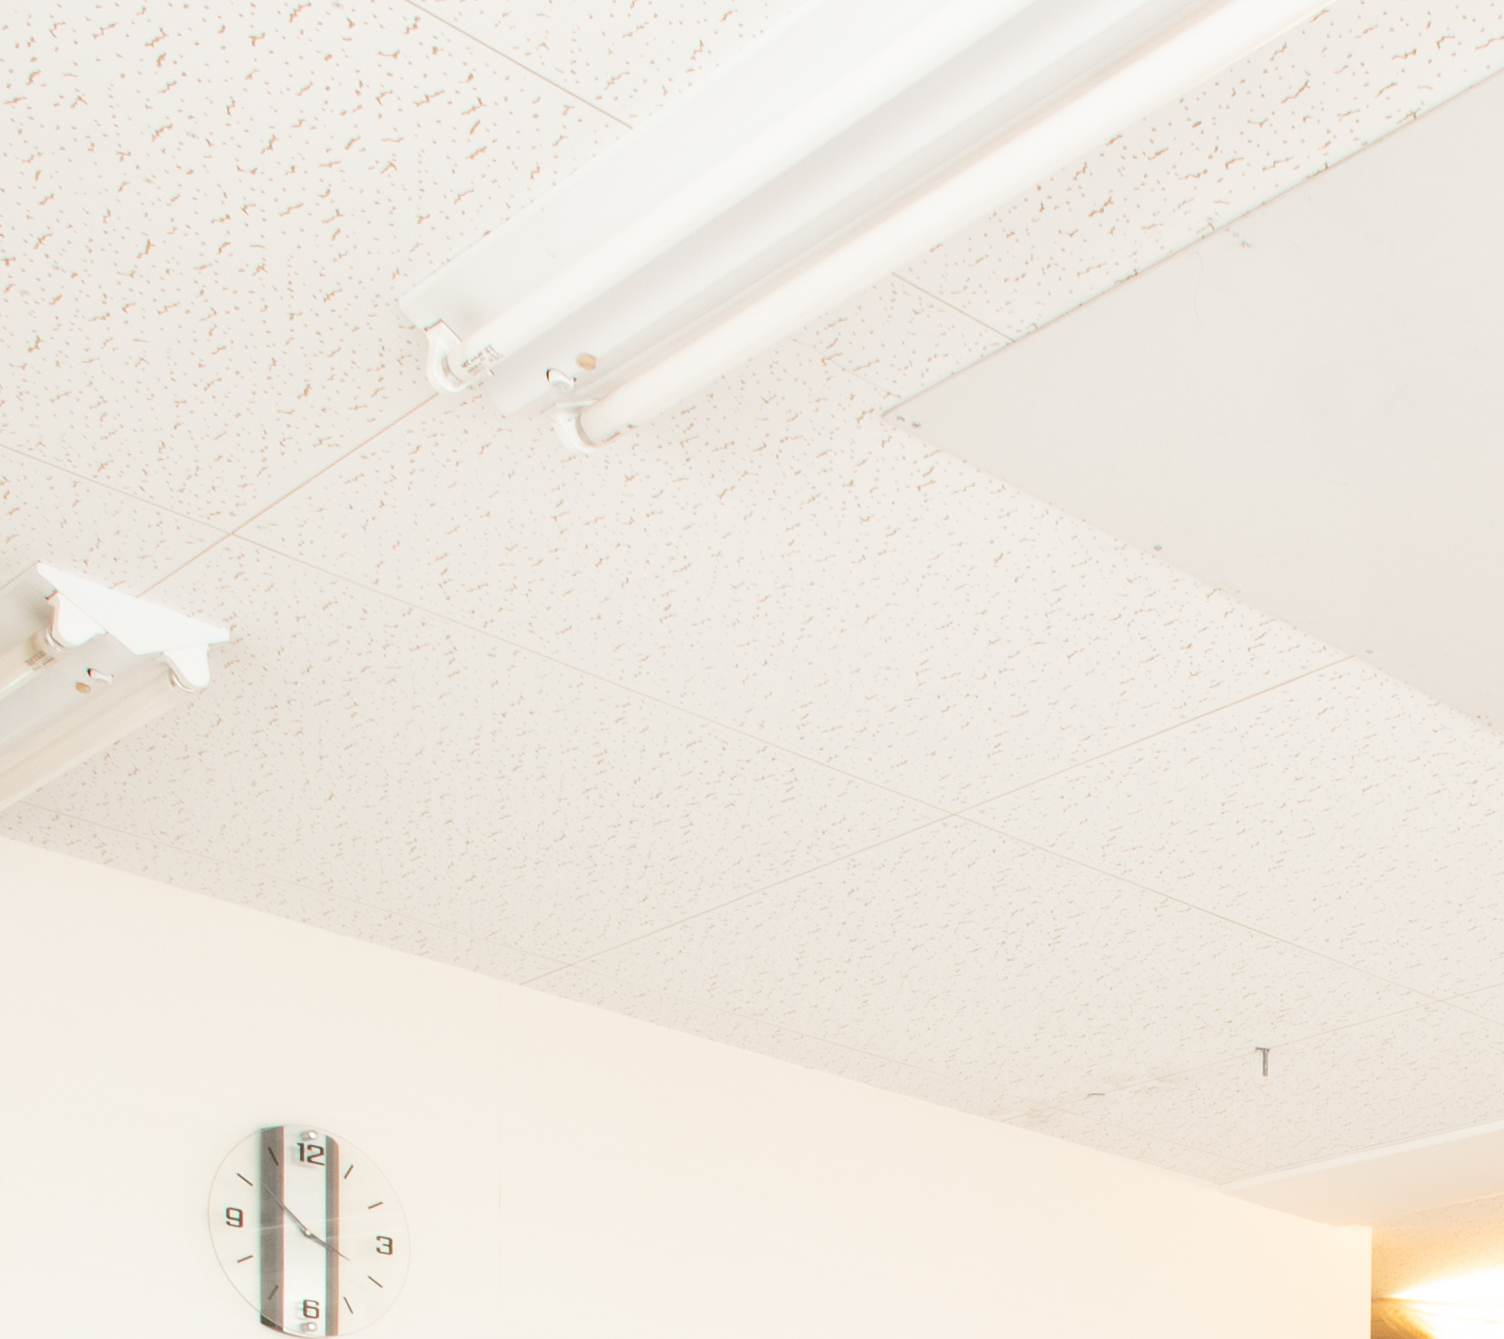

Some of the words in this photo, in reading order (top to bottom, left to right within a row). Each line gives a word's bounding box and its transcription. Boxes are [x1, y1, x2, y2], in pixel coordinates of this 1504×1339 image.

[297, 1143, 325, 1166] 12
[226, 1207, 244, 1228] 9
[376, 1235, 393, 1255] 3
[302, 1299, 320, 1319] 6
